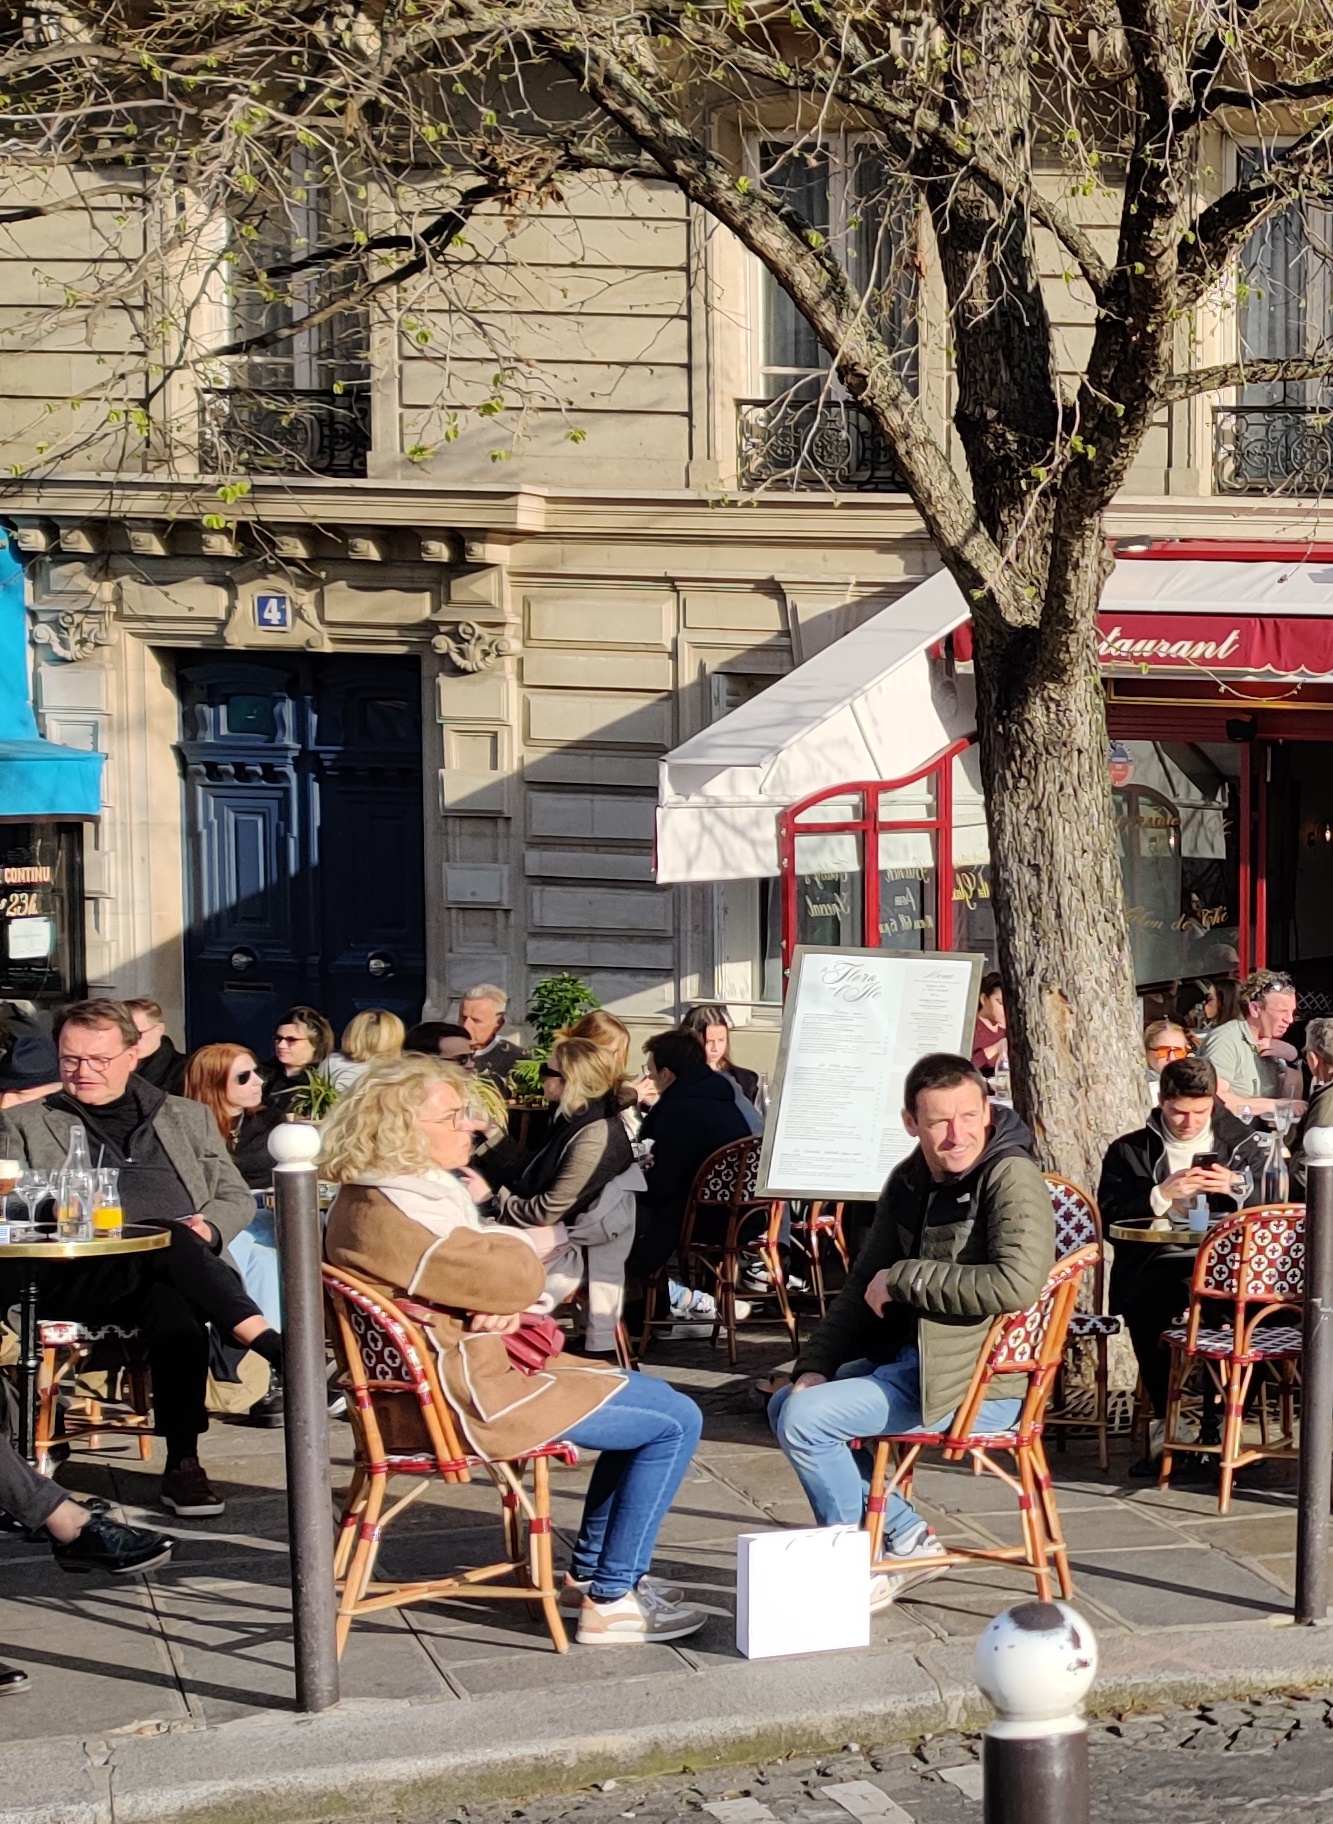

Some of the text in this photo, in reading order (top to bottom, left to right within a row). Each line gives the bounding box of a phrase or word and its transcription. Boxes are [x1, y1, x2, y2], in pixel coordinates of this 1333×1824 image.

[263, 598, 281, 625] 4
[1097, 627, 1241, 660] taurant
[4, 866, 50, 884] CONTINU
